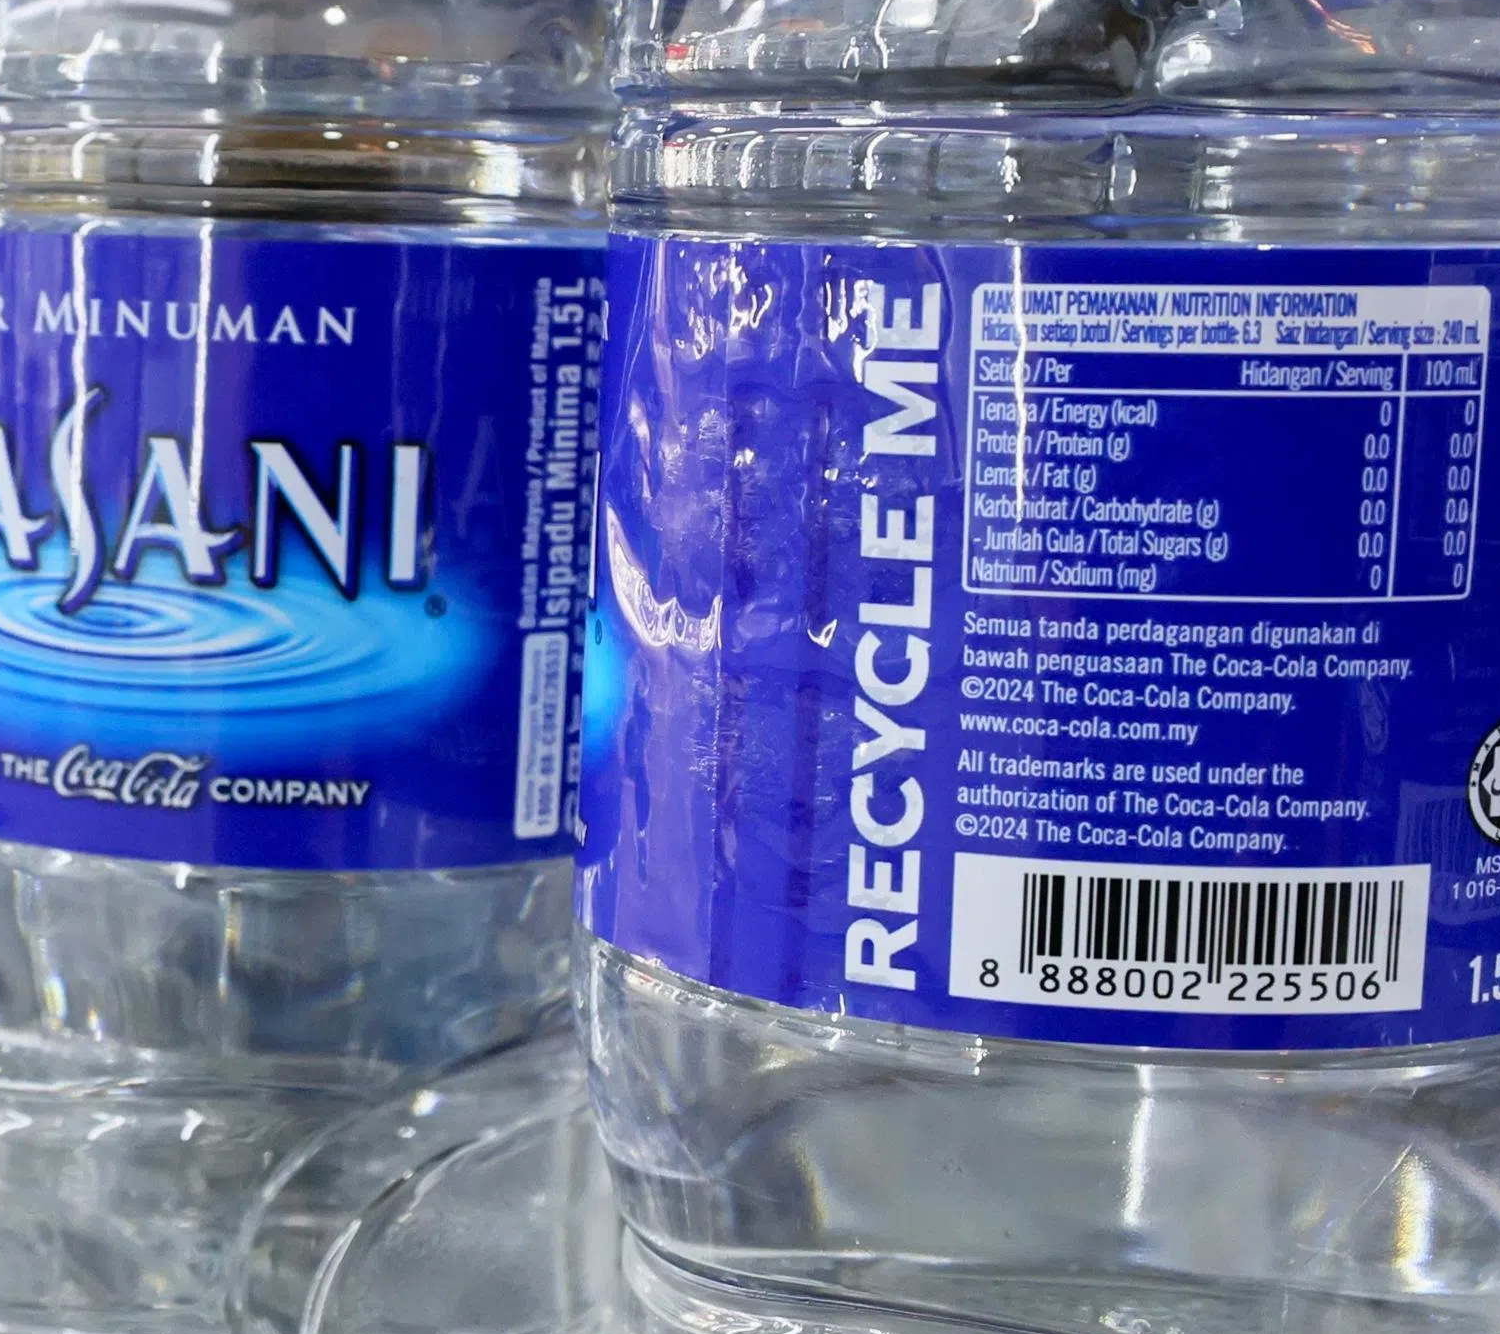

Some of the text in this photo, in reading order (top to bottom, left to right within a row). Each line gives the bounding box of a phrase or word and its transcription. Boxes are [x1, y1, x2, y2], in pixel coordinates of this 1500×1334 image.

[34, 291, 357, 345] MINUMAN
[982, 290, 1063, 316] MAKUMAT
[1067, 291, 1158, 317] PEMAKANAN
[1172, 292, 1251, 317] NUTRITION
[1256, 292, 1358, 318] INFORMATION
[1121, 319, 1174, 349] Servings
[1177, 325, 1199, 349] per
[1243, 320, 1262, 345] 6.3
[1369, 320, 1411, 350] Serving
[1442, 320, 1463, 345] 240
[1045, 358, 1074, 384] Per
[1241, 360, 1322, 392] Hidangan
[1336, 360, 1395, 392] Serving
[1425, 360, 1452, 387] 100
[1052, 398, 1109, 429] Energy
[1111, 398, 1158, 427] (kcal)
[1380, 400, 1392, 427] 0
[1464, 399, 1475, 426] 0
[539, 276, 587, 628] Isipadu Minima 1.5 L
[976, 428, 1032, 454] Proten
[1046, 430, 1103, 456] Protein
[1106, 432, 1130, 462] (g)
[1364, 433, 1390, 460] 0.0
[1450, 432, 1474, 459] 0.0
[1043, 463, 1070, 488] Fat
[1073, 464, 1097, 494] (g)
[1362, 466, 1388, 493] 0.0
[1447, 465, 1471, 491] 0.0
[1083, 495, 1193, 528] Carbohydrate
[1196, 499, 1220, 529] (g)
[1360, 499, 1386, 526] 0.0
[1445, 498, 1468, 524] 0.0
[983, 525, 1042, 552] Jumlah
[1046, 527, 1085, 554] Gula
[1100, 529, 1139, 555] Total
[1142, 530, 1202, 561] Sugars
[1205, 532, 1229, 562] (g)
[1358, 532, 1384, 558] 0.0
[1443, 530, 1466, 556] 0.0
[972, 557, 1036, 583] Natrium
[1051, 559, 1112, 587] Sodium
[1117, 562, 1157, 593] (mg)
[1370, 564, 1381, 591] 0
[1453, 563, 1463, 588] 0
[844, 282, 943, 992] RECYCLE ME
[963, 611, 1380, 649] Semua tanda perdagangan digunakan di
[963, 644, 1414, 682] bawah penguasaan The Coca-Cola Company.
[1041, 680, 1078, 705] The
[1083, 682, 1190, 709] Coca-Cola
[1197, 685, 1297, 715] Company.
[960, 712, 1200, 746] www.coca-cola.com.my
[3, 752, 50, 784] THE
[208, 776, 371, 806] COMPANY
[957, 748, 1305, 786] All trademarks are used under the
[957, 783, 1371, 822] authorization of The Coca-Cola Company.
[1036, 819, 1072, 844] The
[1077, 821, 1184, 849] Coca-Cola
[1190, 825, 1288, 855] Company.
[1452, 882, 1460, 900] 1
[979, 958, 1381, 1003] 8 888002 225506
